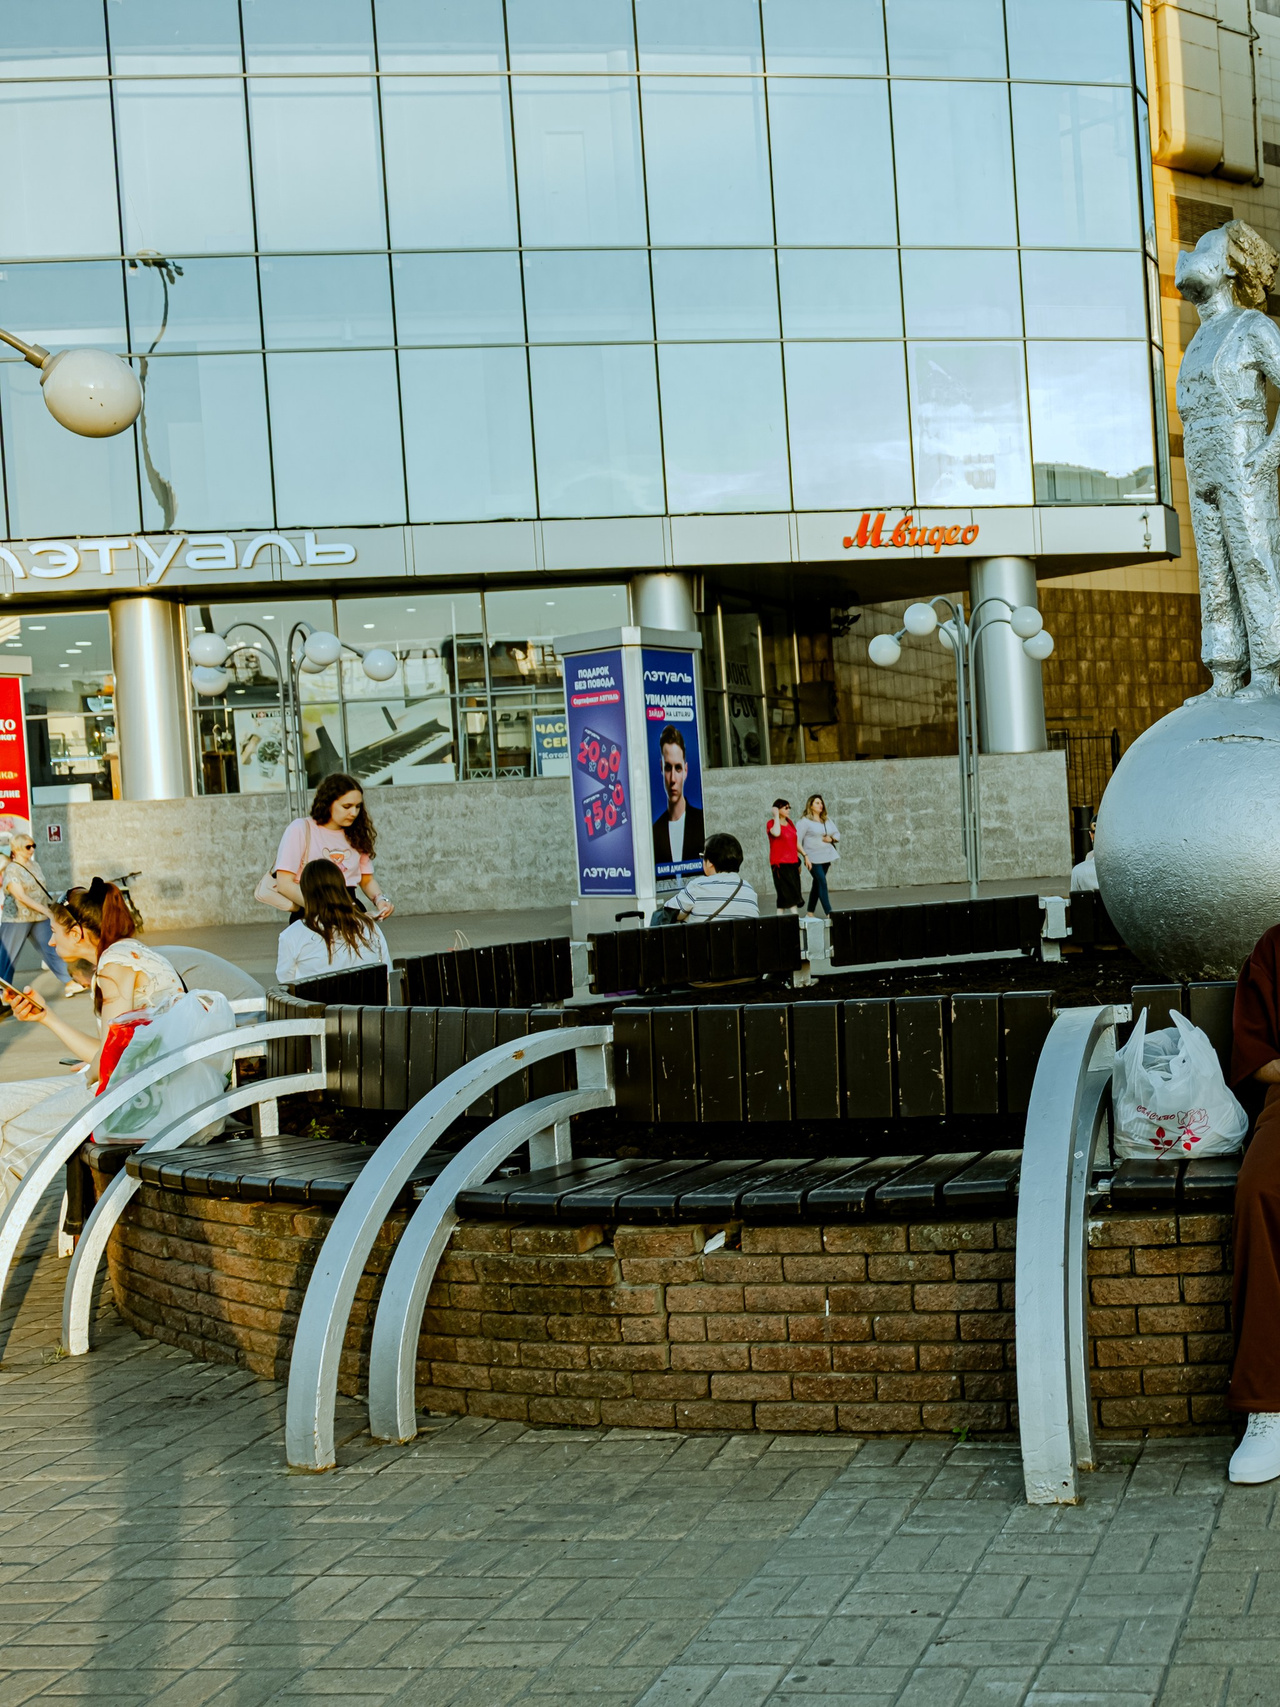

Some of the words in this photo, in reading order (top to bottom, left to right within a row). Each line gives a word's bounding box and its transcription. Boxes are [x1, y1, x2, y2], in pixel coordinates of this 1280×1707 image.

[843, 513, 979, 554] М.видео
[578, 666, 609, 678] ПОДАРОК
[574, 680, 586, 690] БЕЗ
[587, 677, 615, 688] ПОВОДА
[645, 694, 693, 707] УВИДИМСЯ?!
[536, 723, 567, 734] ЧАС
